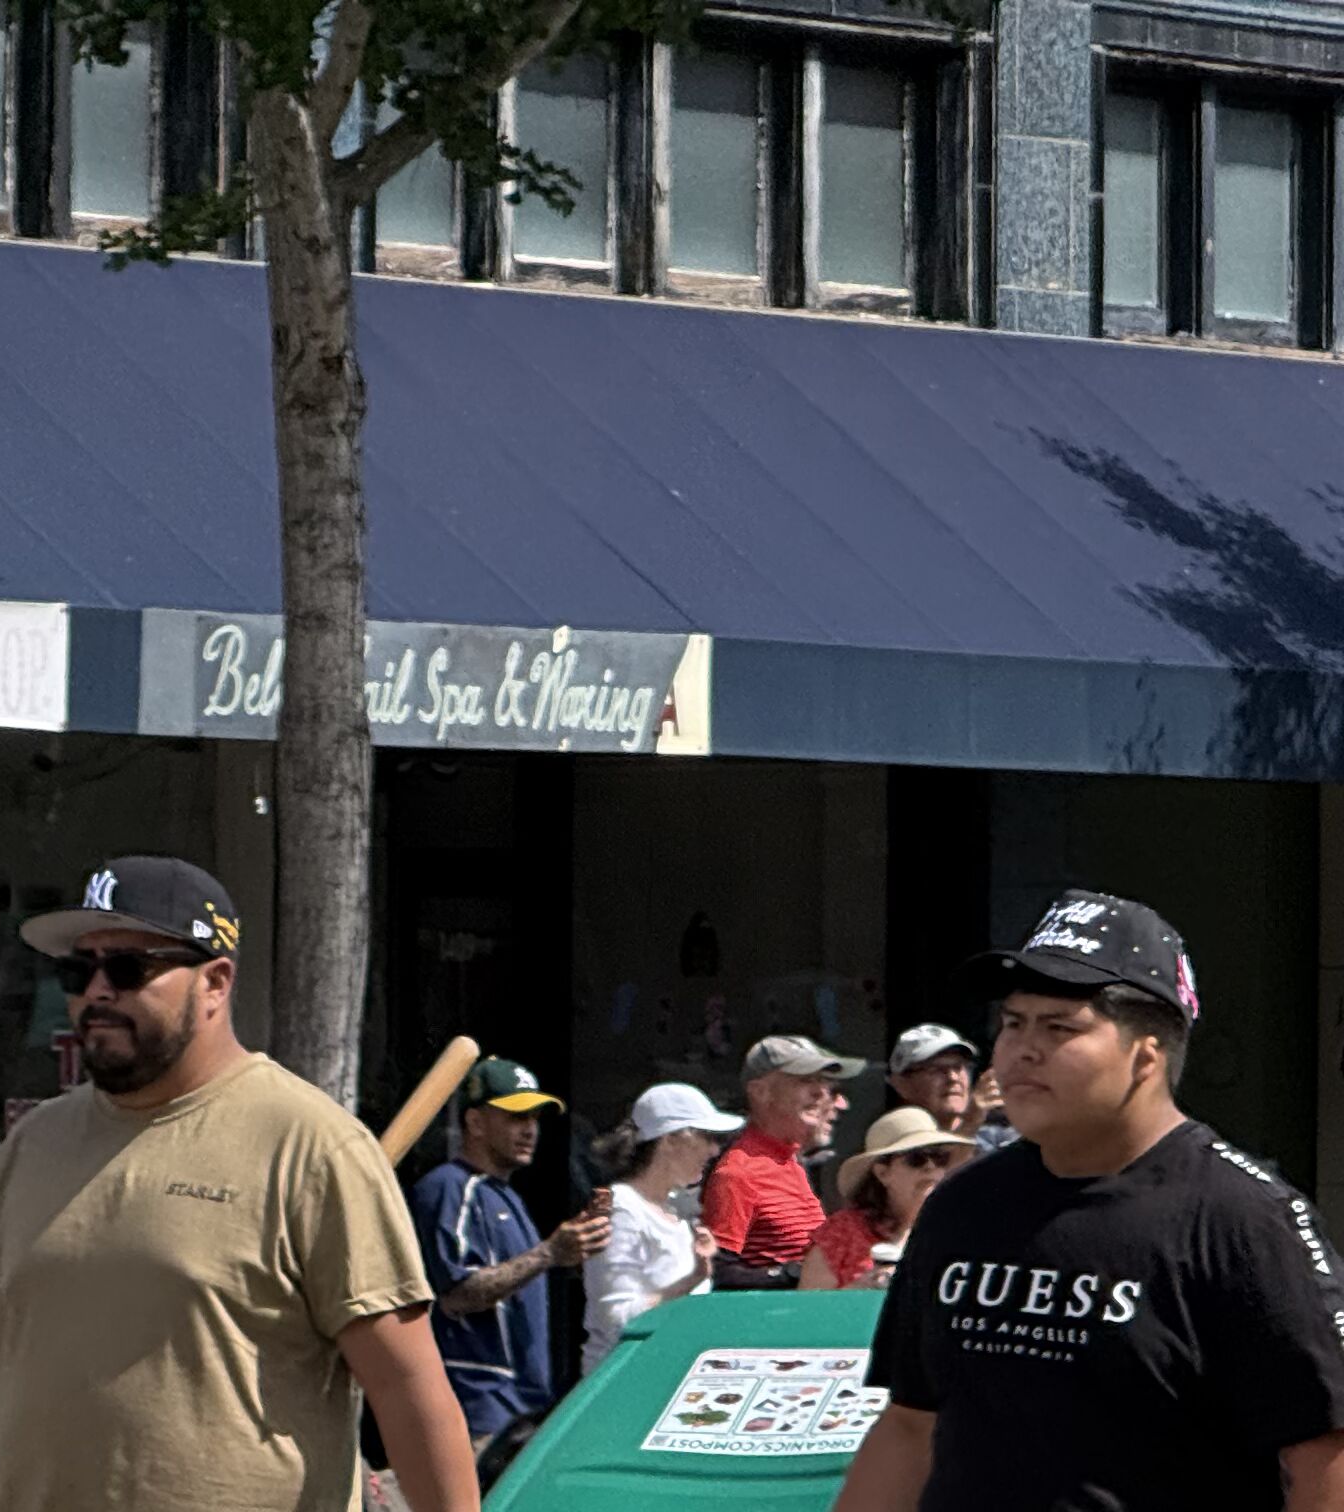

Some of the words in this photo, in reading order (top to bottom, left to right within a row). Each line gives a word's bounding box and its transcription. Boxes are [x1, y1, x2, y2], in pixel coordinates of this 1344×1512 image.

[203, 624, 285, 718] Bel
[418, 646, 484, 741] Spa
[494, 641, 528, 727] &
[529, 650, 655, 751] Waxing
[937, 1261, 1142, 1324] GUESS
[950, 1315, 988, 1332] LOS
[995, 1320, 1090, 1346] ANGELES
[961, 1338, 1075, 1363] CALIFORNIA
